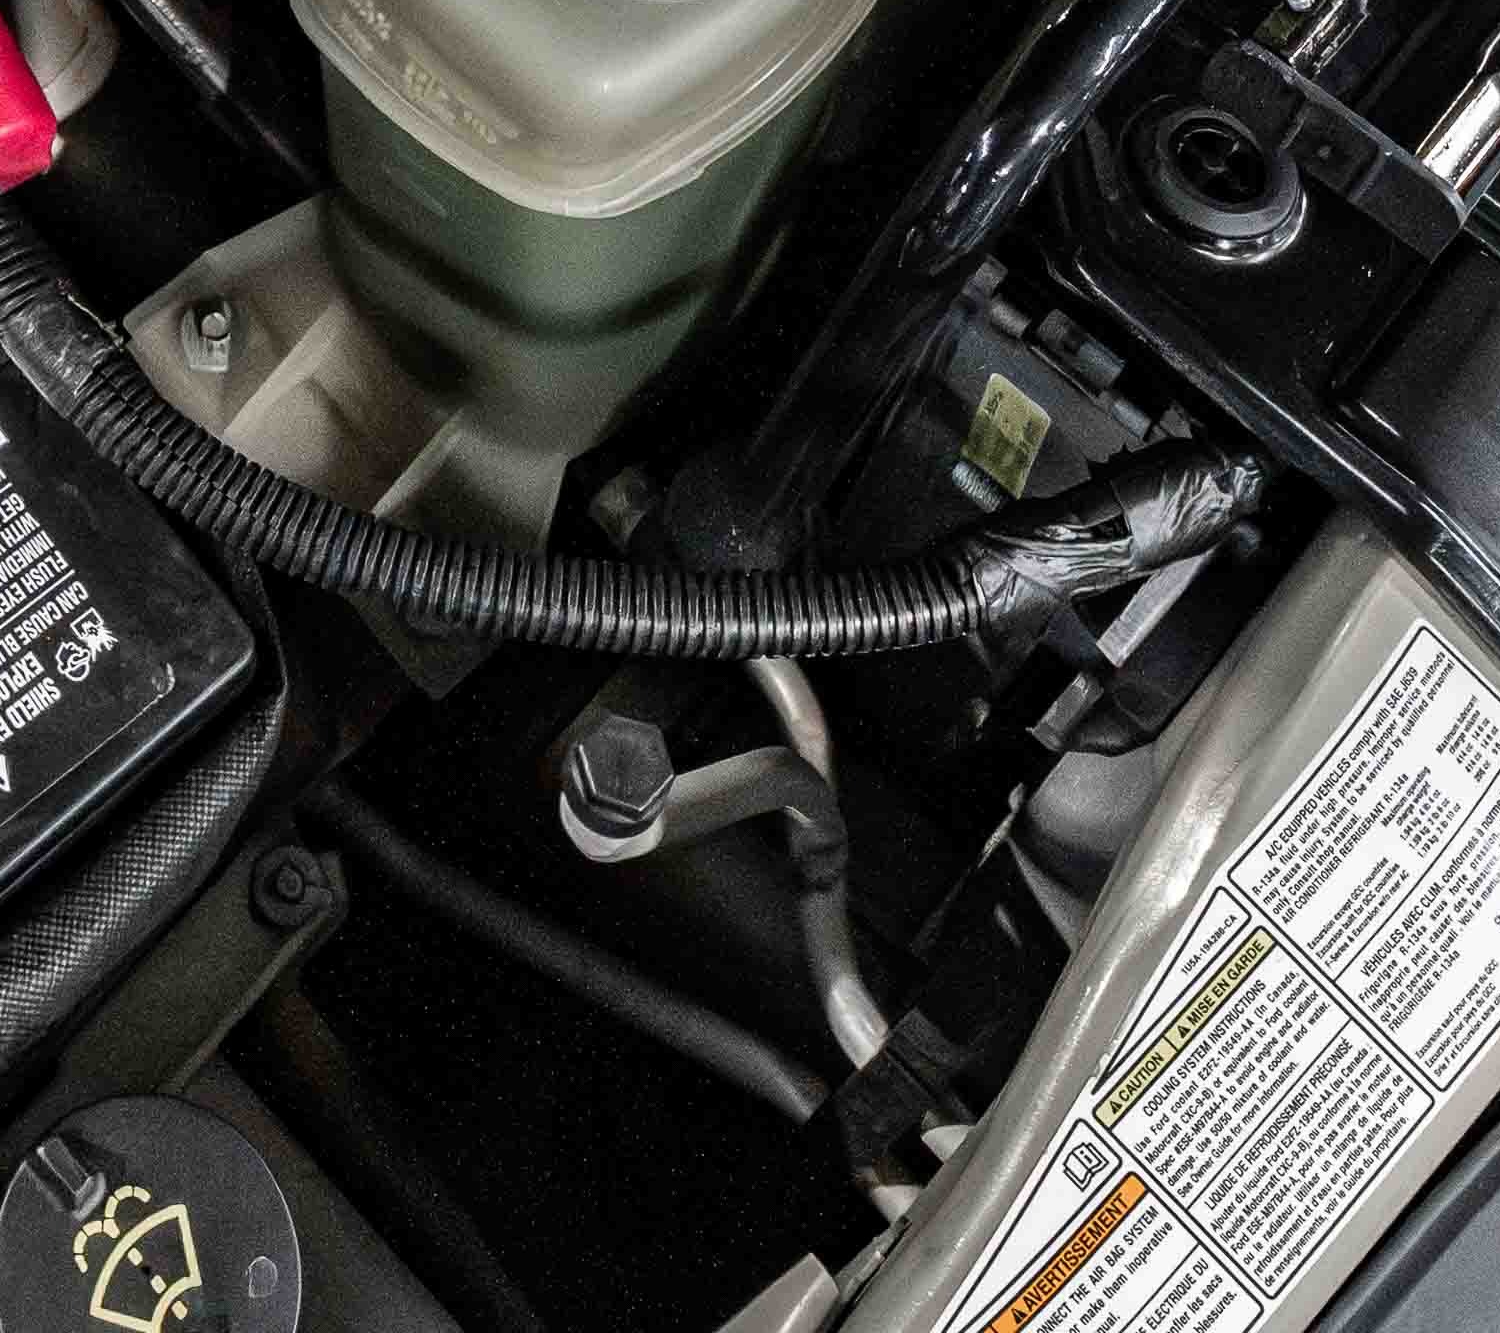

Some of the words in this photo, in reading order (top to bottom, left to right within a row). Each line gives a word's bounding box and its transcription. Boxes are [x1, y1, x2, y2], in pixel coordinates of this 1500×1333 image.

[14, 601, 62, 645] CAUSE
[55, 581, 89, 614] CAN
[5, 677, 61, 729] SHIELD
[1265, 840, 1283, 861] A/C
[1278, 798, 1318, 844] EQUIPPED
[1313, 758, 1351, 801] VEHICLES
[1349, 727, 1377, 761] comply
[1372, 708, 1391, 729] with
[1385, 688, 1404, 709] SAE
[1400, 666, 1418, 692] J639
[1118, 1052, 1164, 1102] CAUTION
[1186, 994, 1216, 1026] MISE
[1211, 978, 1230, 998] EN
[1227, 939, 1265, 980] GARDE
[1143, 1076, 1181, 1117] COOLING
[1176, 1040, 1212, 1079] SYSTEM
[1207, 979, 1266, 1044] INSTRUCTIONS
[1204, 1173, 1238, 1211] LIQUIDE
[1233, 1160, 1249, 1178] DE
[1244, 1084, 1313, 1165] REFROIDISSEMENT
[1309, 1037, 1353, 1089] PRÉCONISÉ
[1022, 1192, 1128, 1312] AVERTISSEMENT
